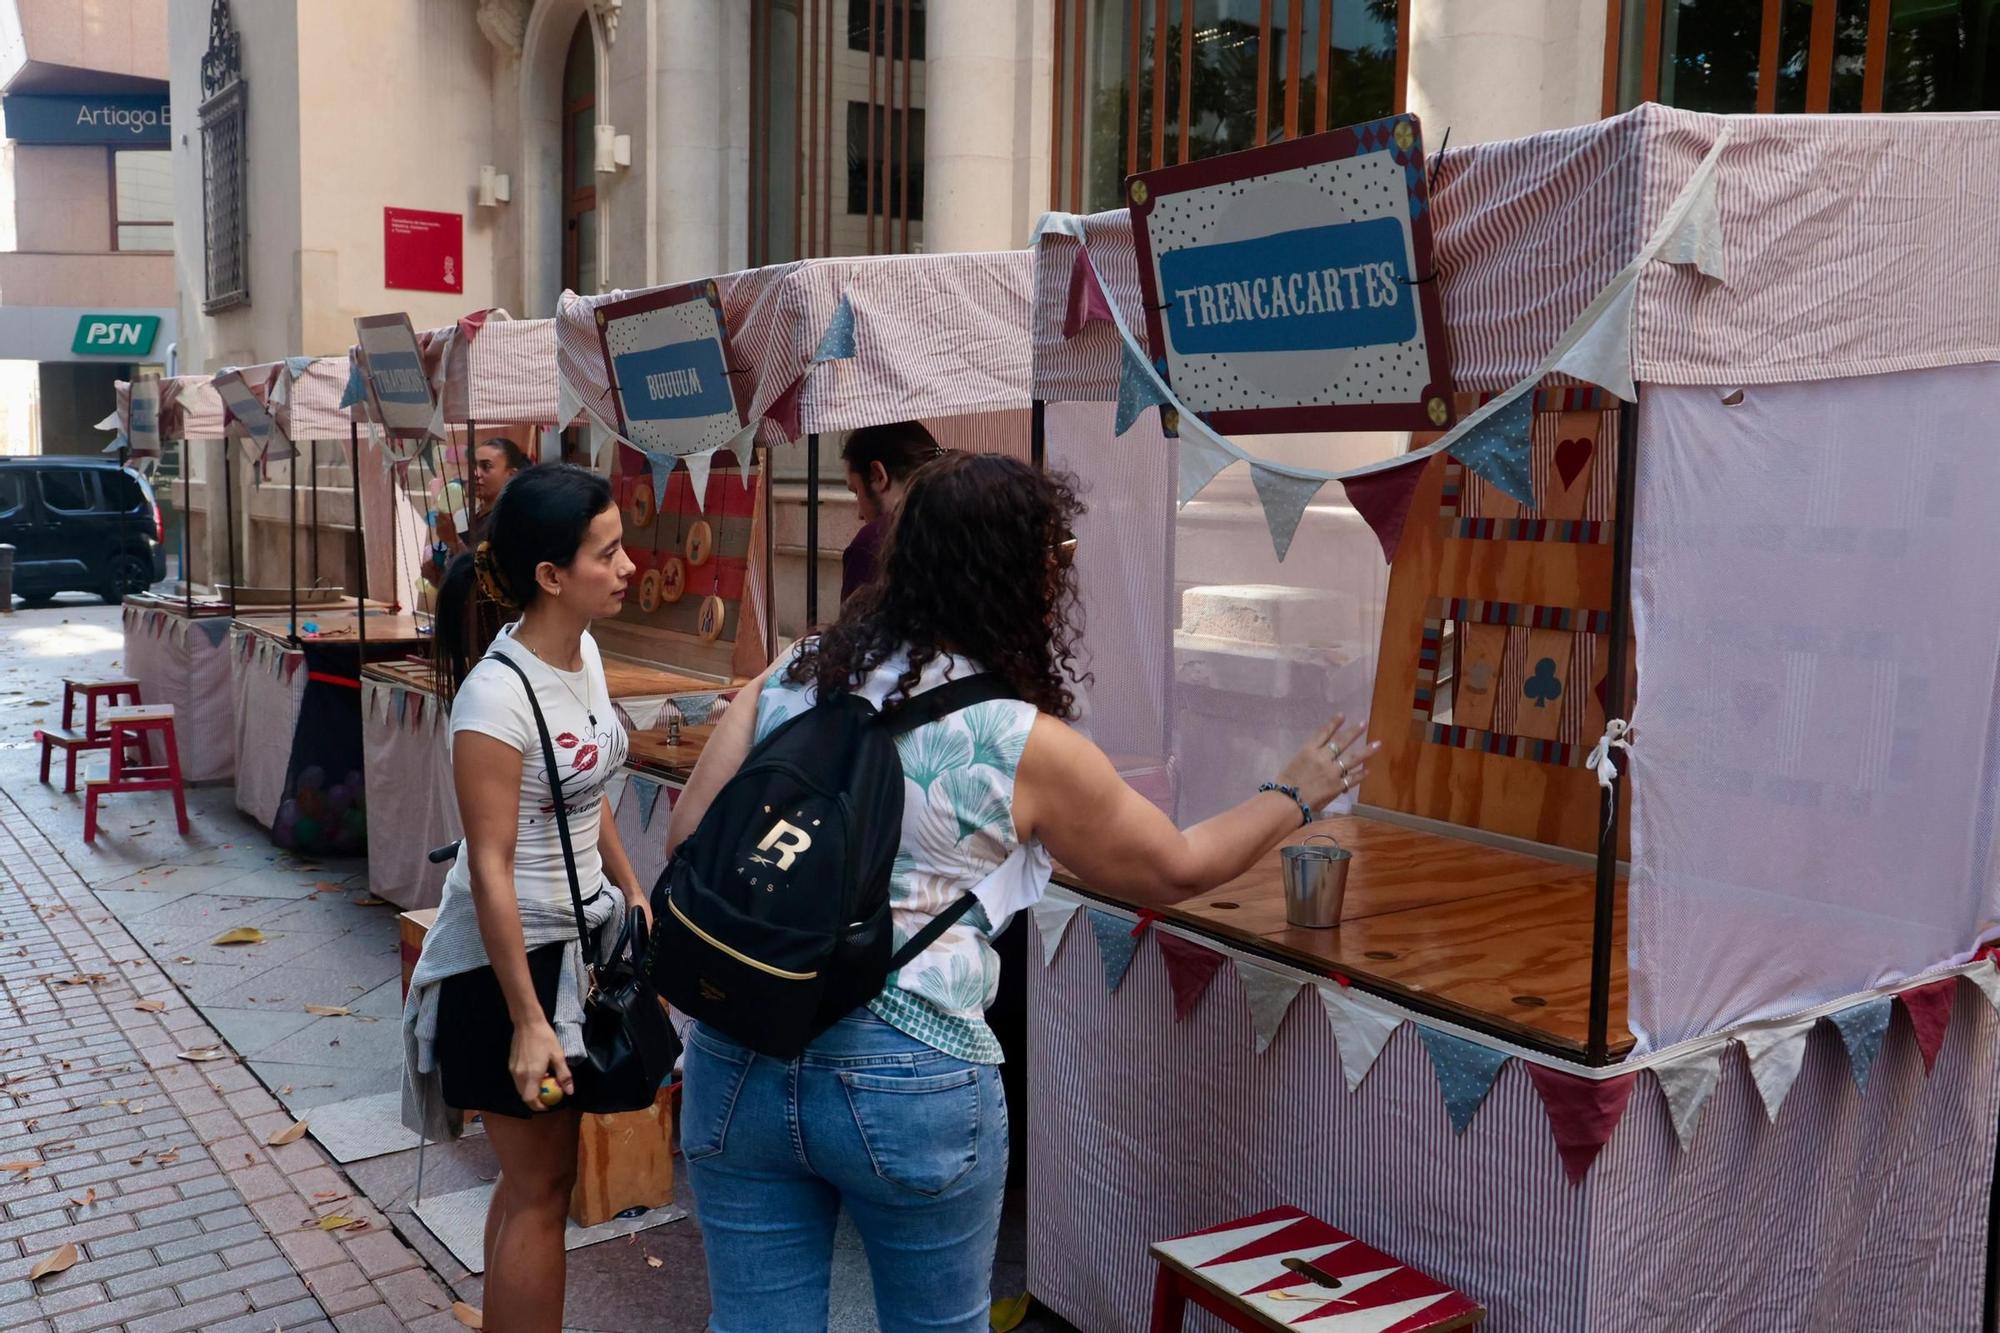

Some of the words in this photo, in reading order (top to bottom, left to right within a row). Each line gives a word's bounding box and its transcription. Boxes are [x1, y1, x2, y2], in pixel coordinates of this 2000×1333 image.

[77, 105, 156, 133] Artiaga
[1175, 261, 1399, 328] TRENCACARTES
[86, 323, 142, 345] PSN
[645, 367, 703, 401] BUUUUM
